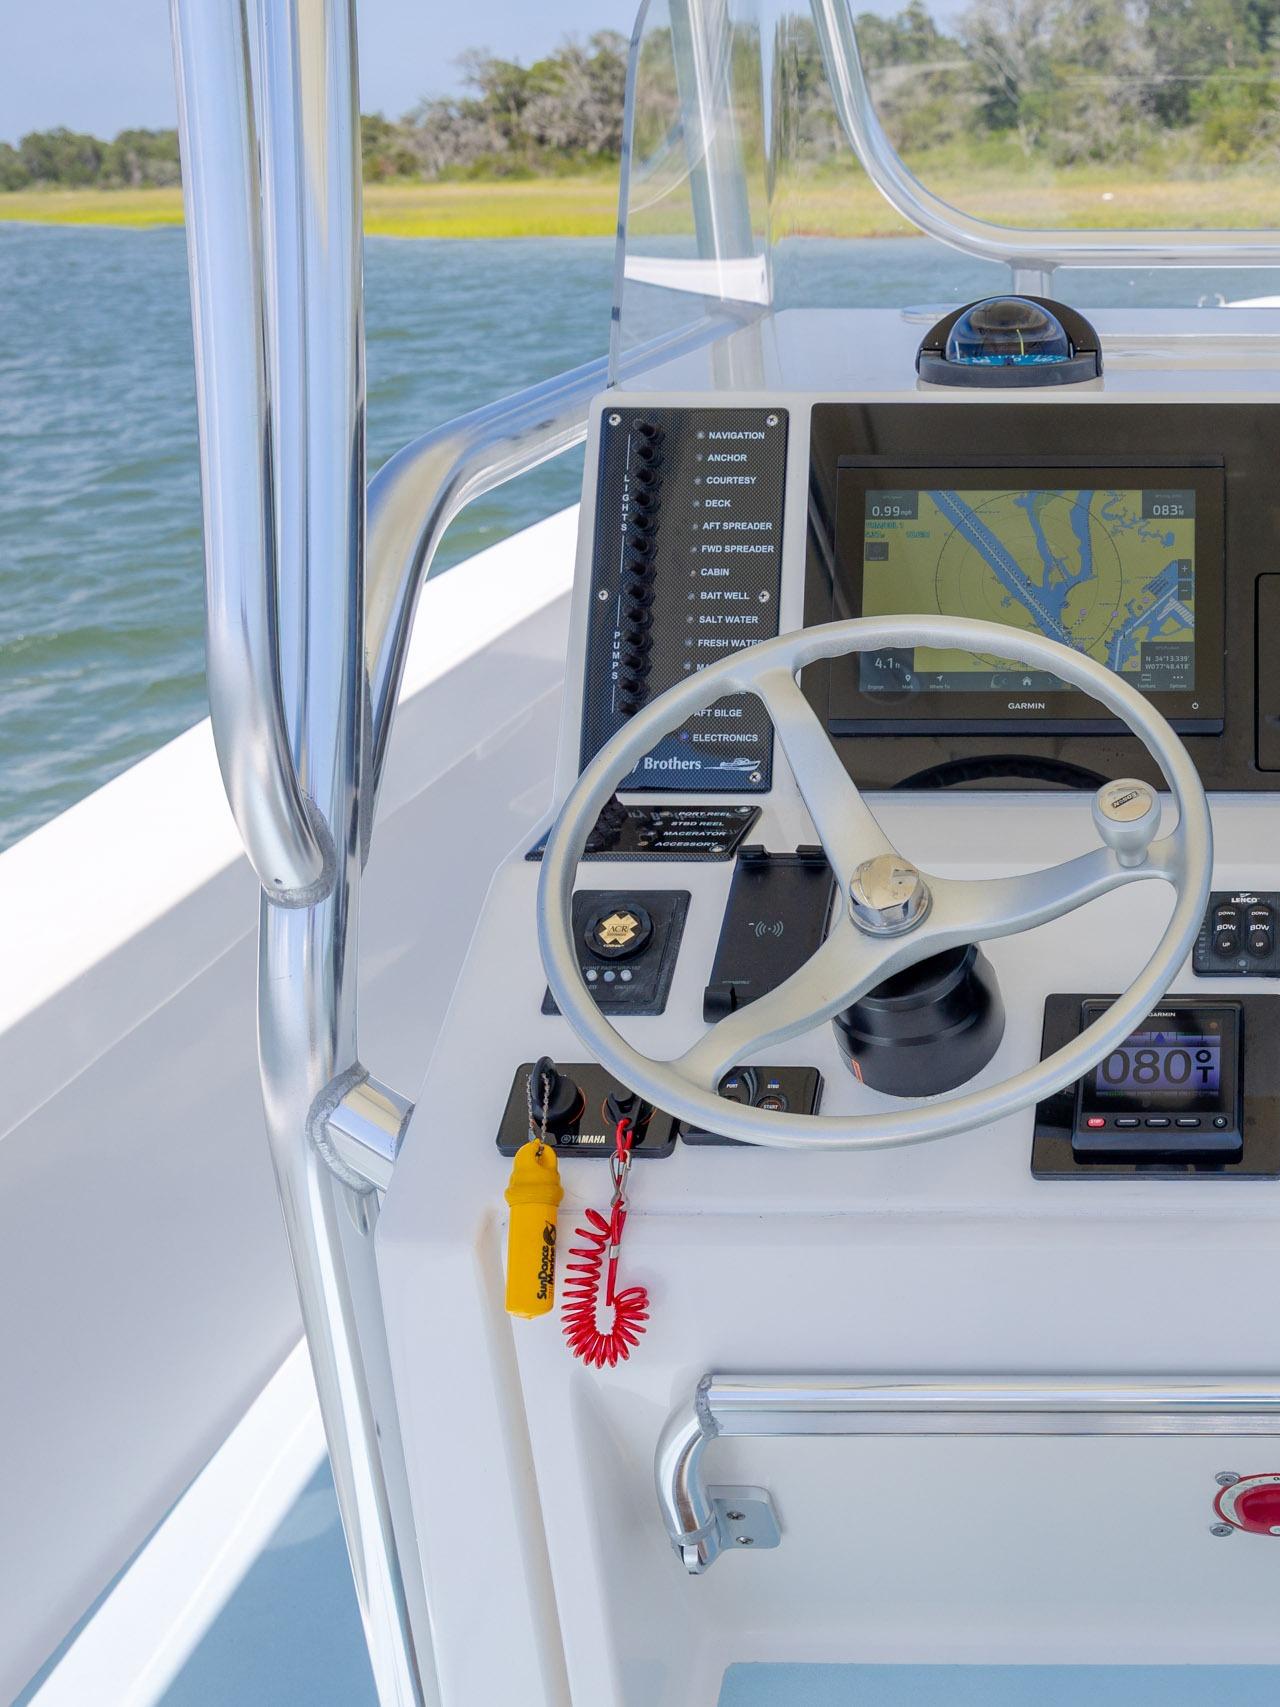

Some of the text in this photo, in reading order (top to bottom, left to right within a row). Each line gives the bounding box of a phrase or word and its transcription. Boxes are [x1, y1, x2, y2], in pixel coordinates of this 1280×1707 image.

[707, 454, 747, 462] ANCHOR
[621, 474, 630, 532] LIGHTS
[872, 506, 900, 516] 0.99
[701, 545, 774, 553] FWD SPREADER
[701, 568, 729, 576] CABIN
[700, 592, 750, 600] BAIT WELL
[698, 639, 729, 647] FRESH
[611, 632, 621, 680] PUMPS
[875, 658, 893, 669] 4.1
[1008, 702, 1045, 710] GARMIN
[694, 709, 742, 717] AFT BILGE
[693, 734, 758, 742] ELECTRONICS
[644, 756, 702, 770] Brothers
[1102, 1049, 1192, 1085] 080
[571, 1135, 606, 1144] YAMAHA
[537, 1245, 549, 1300] SunDance
